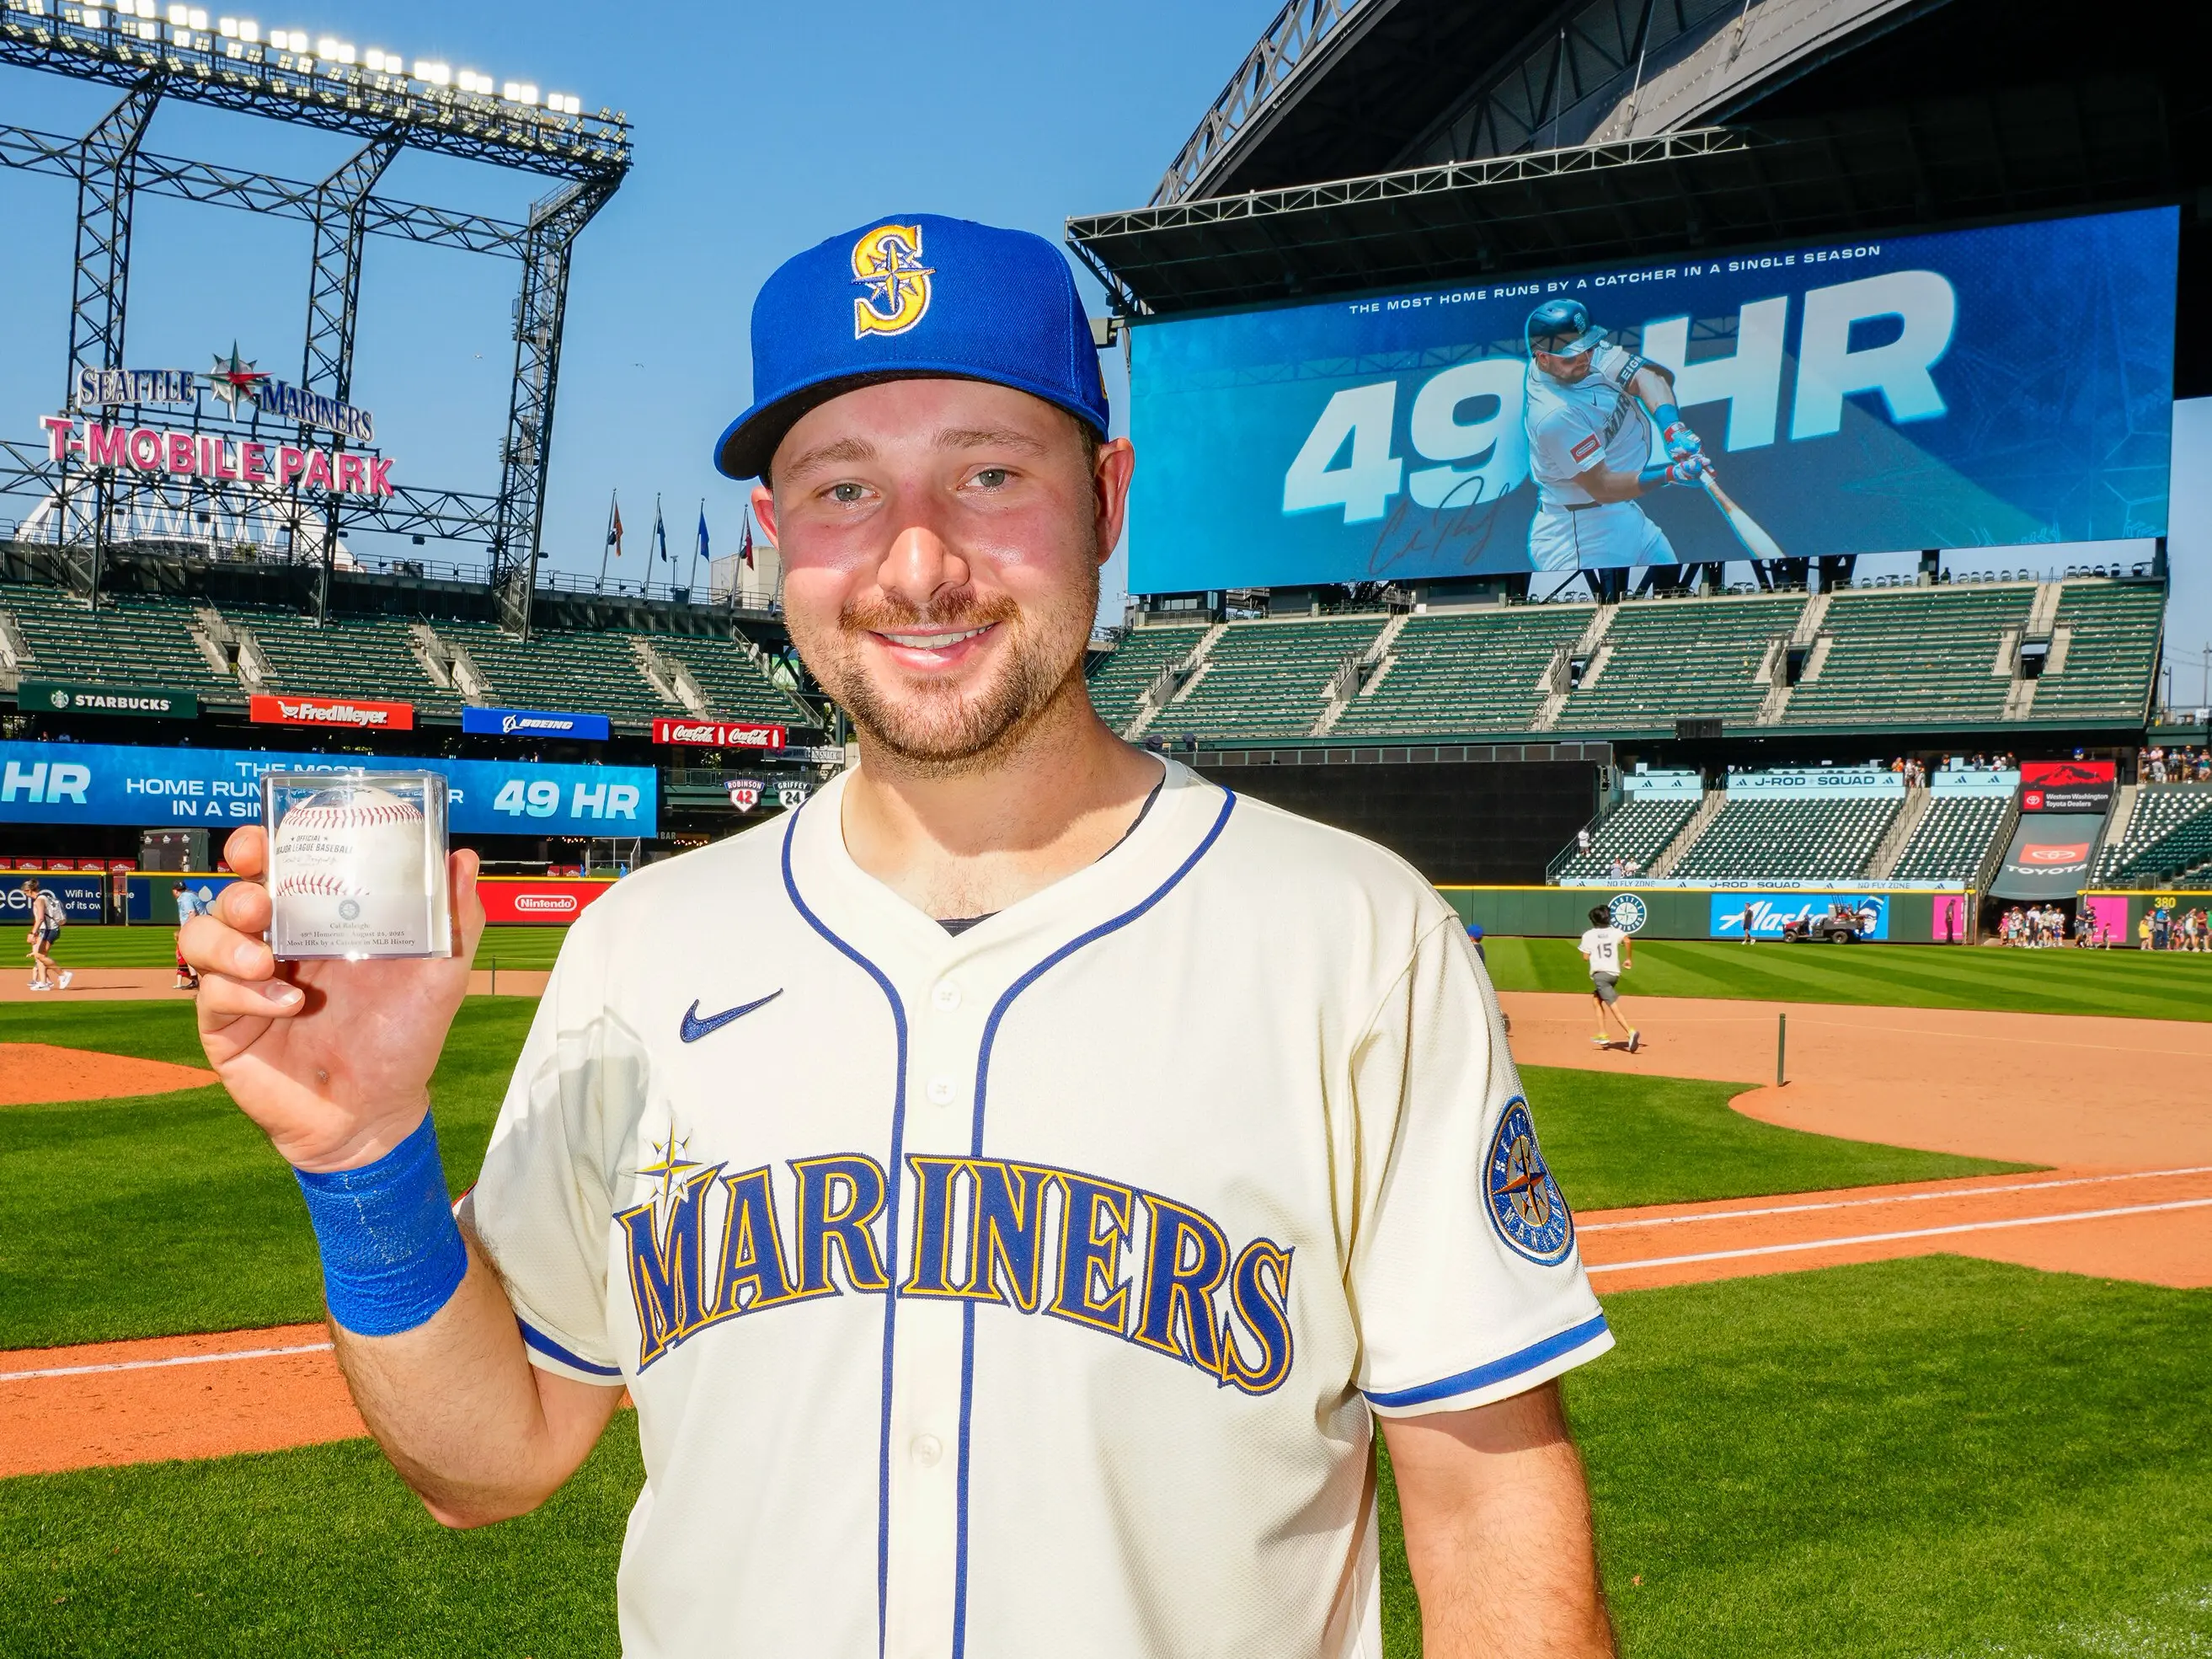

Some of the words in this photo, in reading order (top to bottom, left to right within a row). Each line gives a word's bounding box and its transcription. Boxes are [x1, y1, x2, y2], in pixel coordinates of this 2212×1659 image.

[1349, 302, 1380, 314] THE
[1387, 297, 1433, 311] MOST
[1440, 290, 1487, 305] HOME
[1493, 284, 1540, 299] RUNS
[1547, 281, 1568, 292] BY
[1576, 279, 1587, 289] A
[1595, 269, 1676, 286] CATCHER
[1684, 265, 1702, 277] IN
[1709, 264, 1720, 274] A
[1728, 254, 1796, 272] SINGLE
[1803, 245, 1881, 263] SEASON
[1283, 358, 1528, 524] 49
[1643, 270, 1957, 469] HR
[77, 367, 195, 409] SEATTLE
[259, 377, 374, 444] MARINERS
[40, 415, 267, 484] T-MOBILE
[275, 445, 397, 499] PARK
[75, 695, 170, 711] STARBUCKS
[520, 718, 574, 730] BOEING
[1, 761, 91, 804] HR
[126, 779, 204, 796] HOME
[727, 779, 762, 790] ROBINSON
[777, 780, 808, 790] GRIFFEY
[1755, 777, 1806, 787] J-ROD
[1818, 775, 1874, 786] SQUAD
[494, 779, 560, 817] 49
[571, 783, 640, 821] HR
[736, 789, 753, 805] 42
[785, 791, 801, 805] 24
[2072, 793, 2108, 801] Washington
[173, 800, 197, 816] IN
[205, 801, 222, 816] A
[660, 831, 676, 840] BAR
[275, 844, 291, 854] MAJOR
[292, 843, 313, 852] LEAGUE
[316, 843, 353, 854] BASEBALL
[2006, 864, 2088, 875] TOYOTA
[1889, 881, 1910, 890] ZONE
[65, 889, 83, 898] Wifi
[85, 889, 93, 898] in
[65, 901, 72, 909] of
[77, 901, 87, 909] its
[520, 898, 571, 908] Nintendo
[1610, 896, 1643, 911] SEATTLE
[2154, 897, 2177, 908] 380
[1596, 942, 1612, 959] 15
[612, 1153, 1296, 1396] MARINERS
